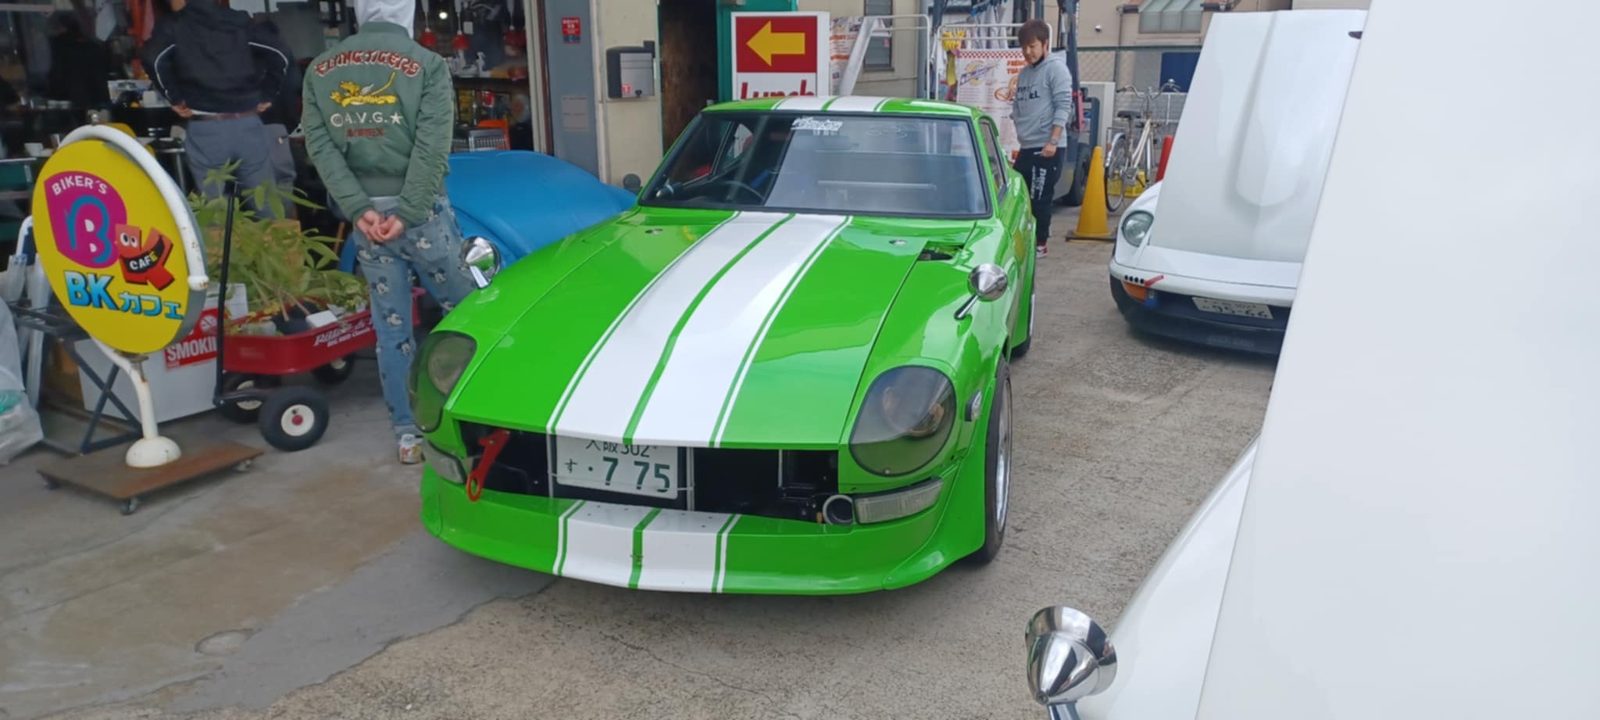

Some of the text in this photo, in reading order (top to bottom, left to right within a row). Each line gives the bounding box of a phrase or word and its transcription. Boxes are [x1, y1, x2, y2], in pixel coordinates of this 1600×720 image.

[64, 270, 119, 310] BK
[119, 291, 185, 320] カフェ
